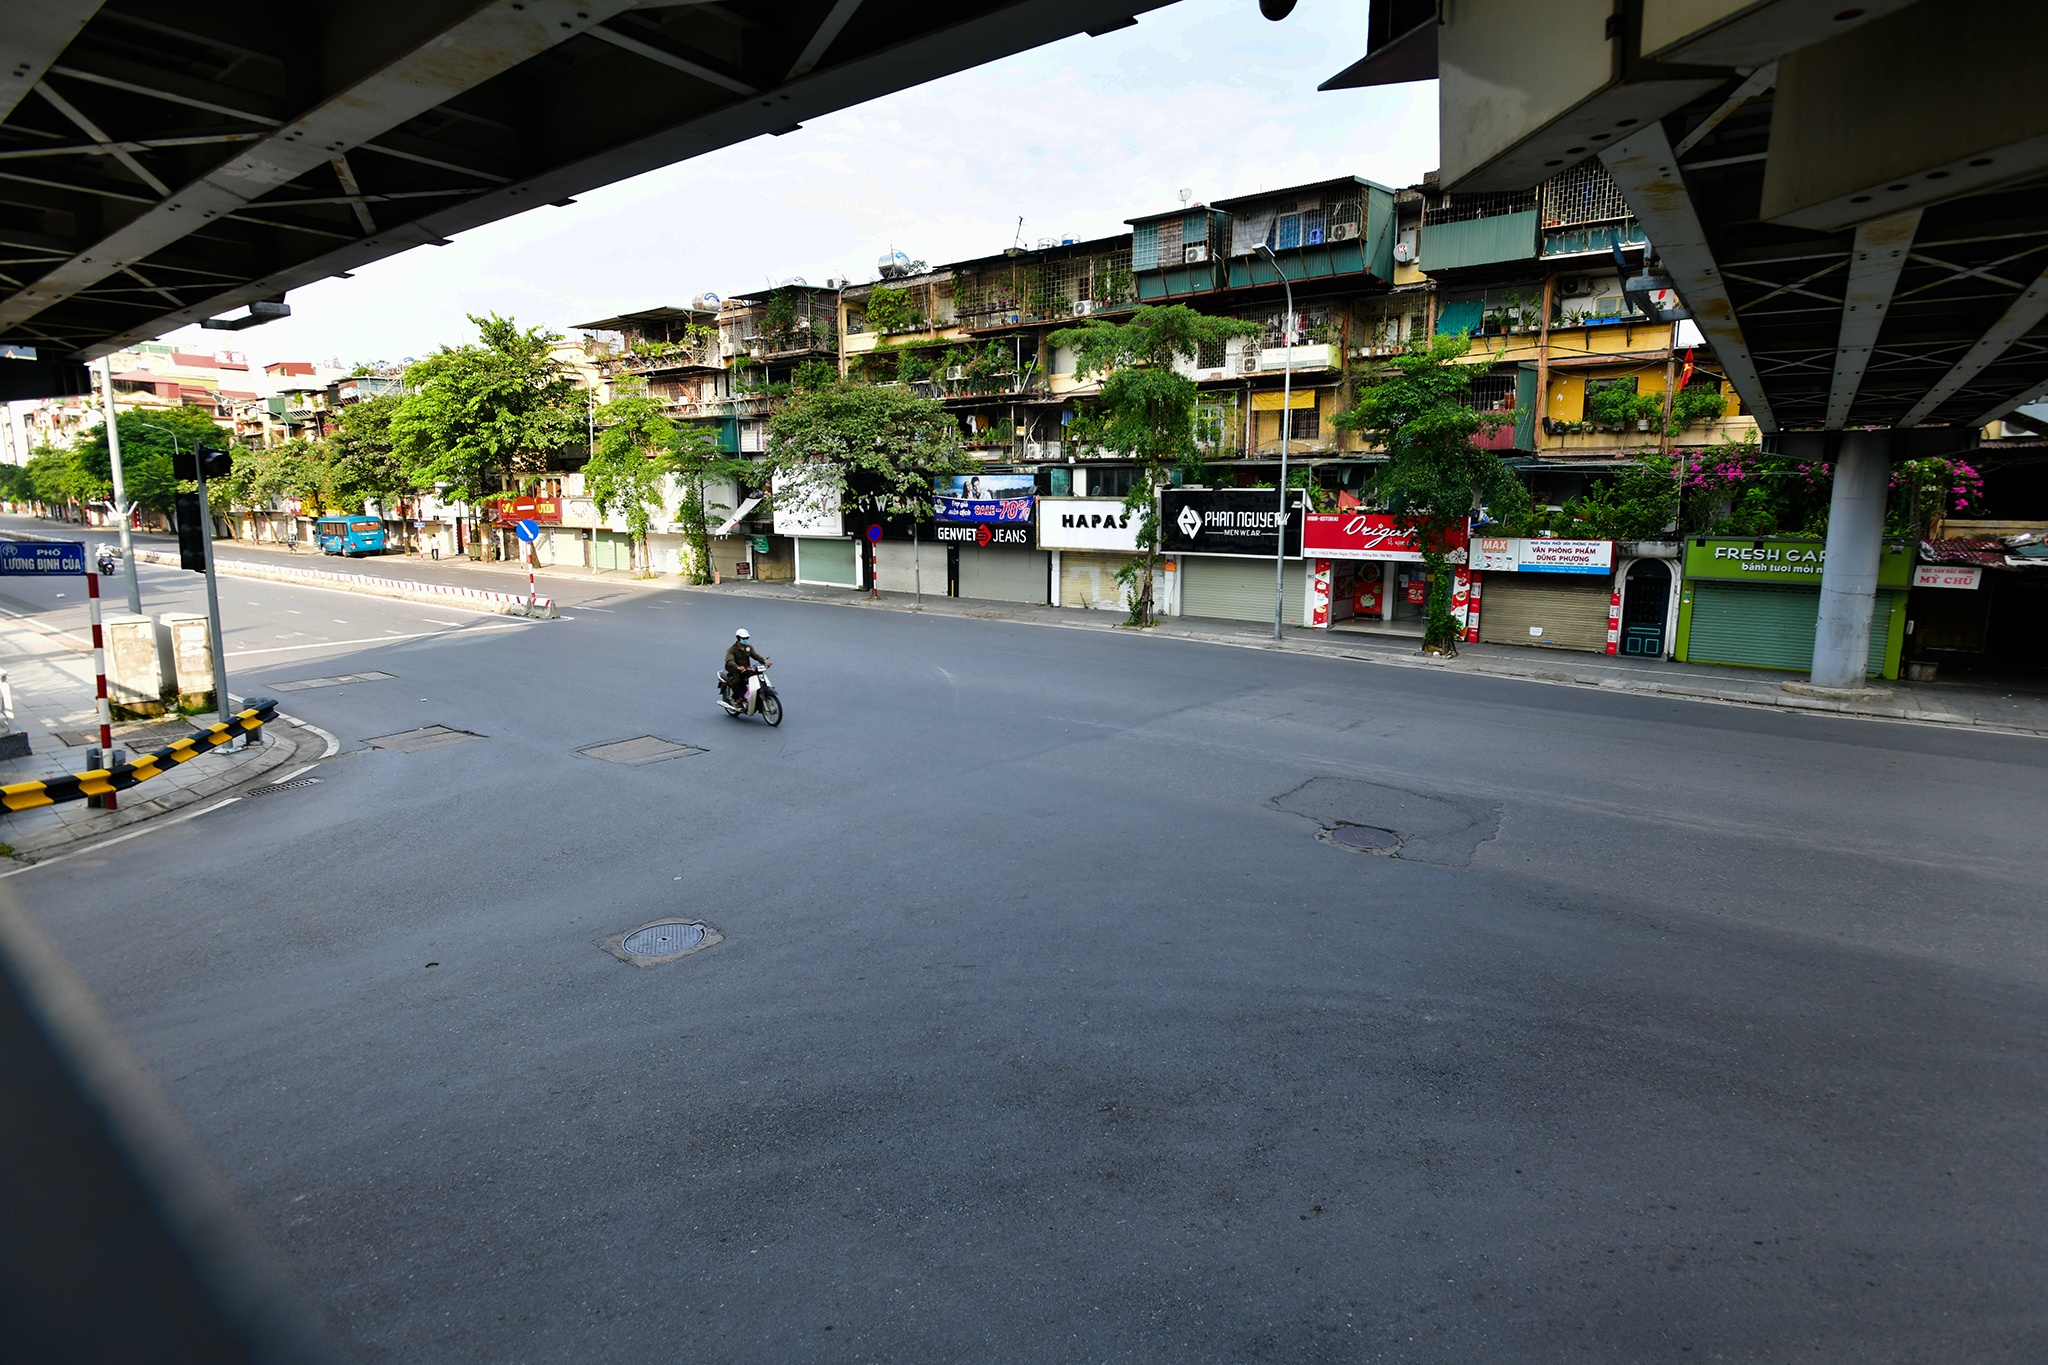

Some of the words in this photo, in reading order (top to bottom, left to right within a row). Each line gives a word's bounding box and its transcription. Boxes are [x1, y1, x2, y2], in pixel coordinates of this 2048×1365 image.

[974, 505, 996, 515] SALE
[1062, 514, 1128, 529] HAPAS
[1205, 512, 1234, 527] PHAN
[937, 527, 977, 541] GENVIET
[993, 529, 1027, 543] JEANS
[1343, 516, 1417, 548] Origat
[1482, 540, 1507, 549] MAX
[1575, 546, 1596, 554] PHẨM
[36, 547, 61, 556] PHỐ
[1536, 553, 1556, 561] DŨNG
[1715, 547, 1780, 560] FRESH
[3, 557, 35, 570] LƯƠNG
[37, 558, 60, 572] ĐỊNH
[62, 554, 81, 570] CỦA
[1742, 563, 1767, 571] bánh
